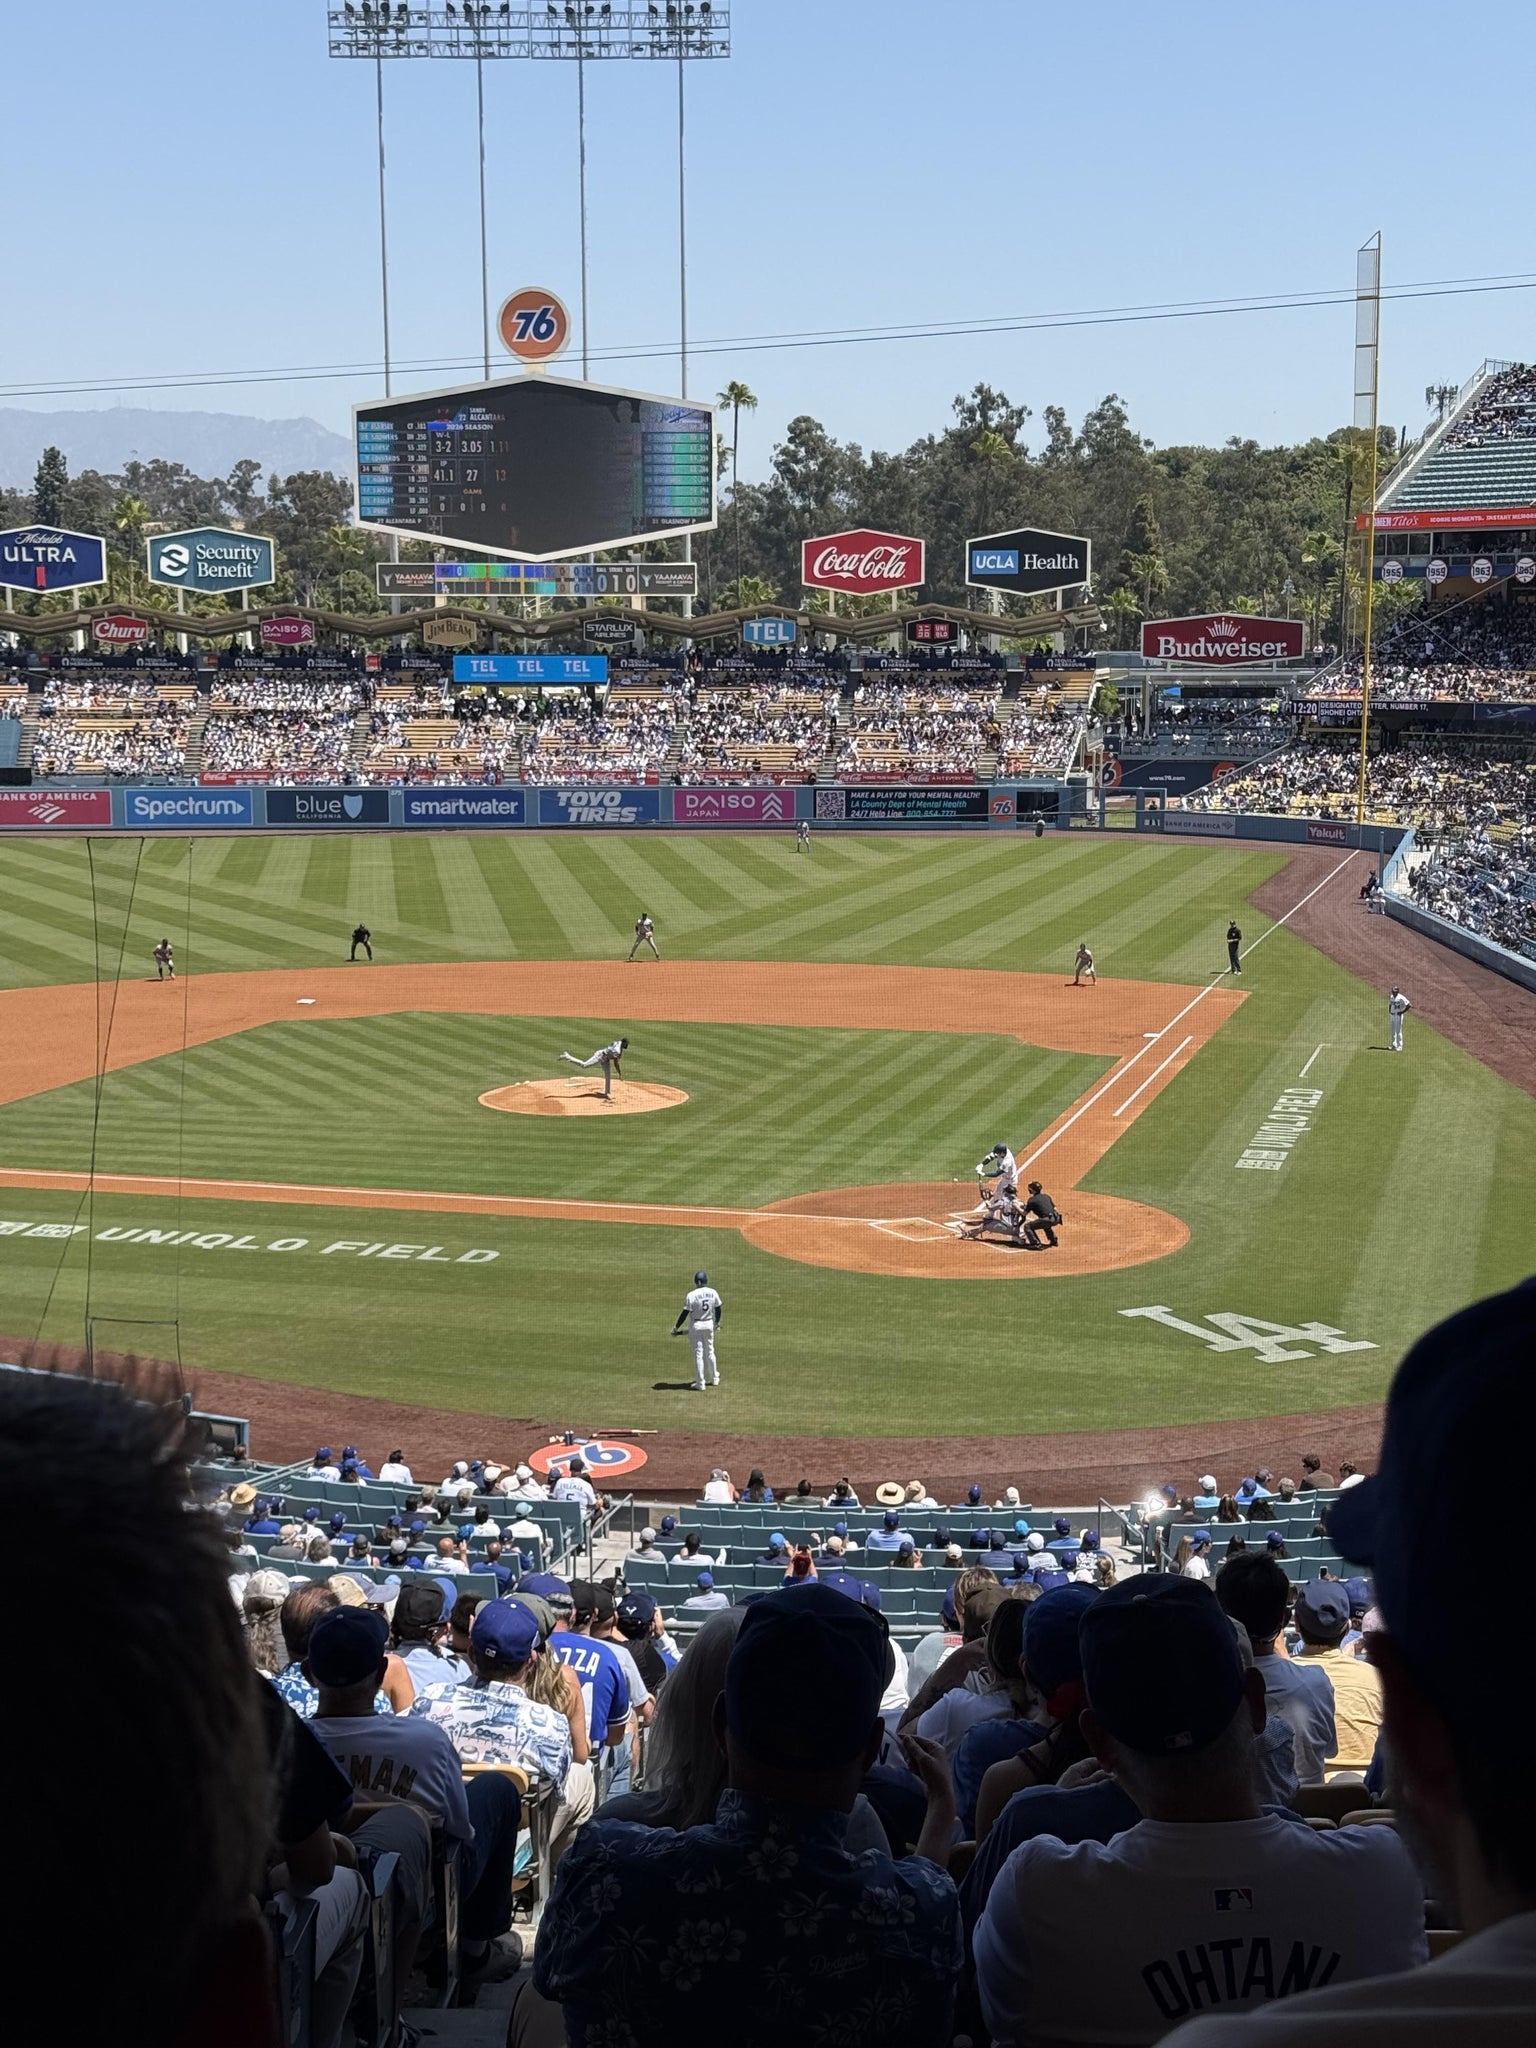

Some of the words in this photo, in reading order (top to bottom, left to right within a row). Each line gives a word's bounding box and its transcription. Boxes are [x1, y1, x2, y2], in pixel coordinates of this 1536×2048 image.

[511, 305, 558, 343] 76
[464, 423, 494, 431] SEASON
[435, 440, 452, 453] 3-2
[461, 440, 482, 453] 3.05
[434, 469, 454, 482] 41.1
[466, 469, 478, 482] 27
[495, 469, 507, 482] 13
[439, 503, 446, 512] 0
[460, 503, 466, 512] 0
[480, 503, 486, 512] 0
[1392, 515, 1419, 527] Tito's
[14, 532, 64, 545] Michelob
[4, 546, 77, 563] ULTRA
[196, 543, 261, 563] Security
[813, 546, 912, 580] Coca-Cola
[975, 555, 1015, 569] UCLA
[1023, 553, 1079, 570] Health
[197, 562, 254, 579] Benefit
[1382, 567, 1401, 575] 1955
[1427, 567, 1446, 575] 1959
[596, 574, 607, 592] 0
[612, 574, 619, 592] 1
[625, 574, 636, 592] 0
[95, 622, 145, 638] Churu
[263, 624, 299, 633] DAISO
[427, 622, 445, 640] JIM
[446, 620, 472, 640] BEAM
[586, 623, 633, 632] STARLUX
[749, 622, 790, 641] TEL
[1157, 636, 1288, 658] Budweiser
[470, 660, 498, 672] TEL
[517, 660, 544, 672] TEL
[563, 660, 590, 672] TEL
[1293, 702, 1318, 714] 12:20
[1364, 703, 1389, 711] ITTER,
[29, 793, 41, 801] OF
[42, 792, 97, 801] AMERICA
[557, 791, 622, 807] TOYO
[686, 795, 756, 809] DAISO
[850, 791, 870, 799] MAKE
[870, 791, 876, 799] A
[876, 791, 894, 799] PLAY
[894, 791, 908, 799] FOR
[908, 791, 926, 799] YOUR
[927, 791, 952, 799] MENTAL
[953, 791, 981, 799] HEALTH!
[134, 796, 237, 819] Spectrum
[295, 795, 342, 814] blue
[410, 800, 517, 815] smartwater
[861, 800, 886, 809] County
[888, 800, 905, 809] Dept
[916, 800, 941, 808] Mental
[942, 800, 967, 808] Health
[992, 801, 1012, 815] 76
[567, 806, 638, 823] TIRES
[850, 810, 868, 818] 24/7
[869, 810, 885, 818] Help
[1192, 821, 1221, 829] AMERICA
[1309, 826, 1346, 840] Yakult
[95, 1226, 309, 1252] UNIQLO
[318, 1239, 500, 1265] FIELD
[702, 1299, 710, 1311] 5
[1117, 1305, 1381, 1364] LA
[808, 1950, 869, 1978] Dodgers
